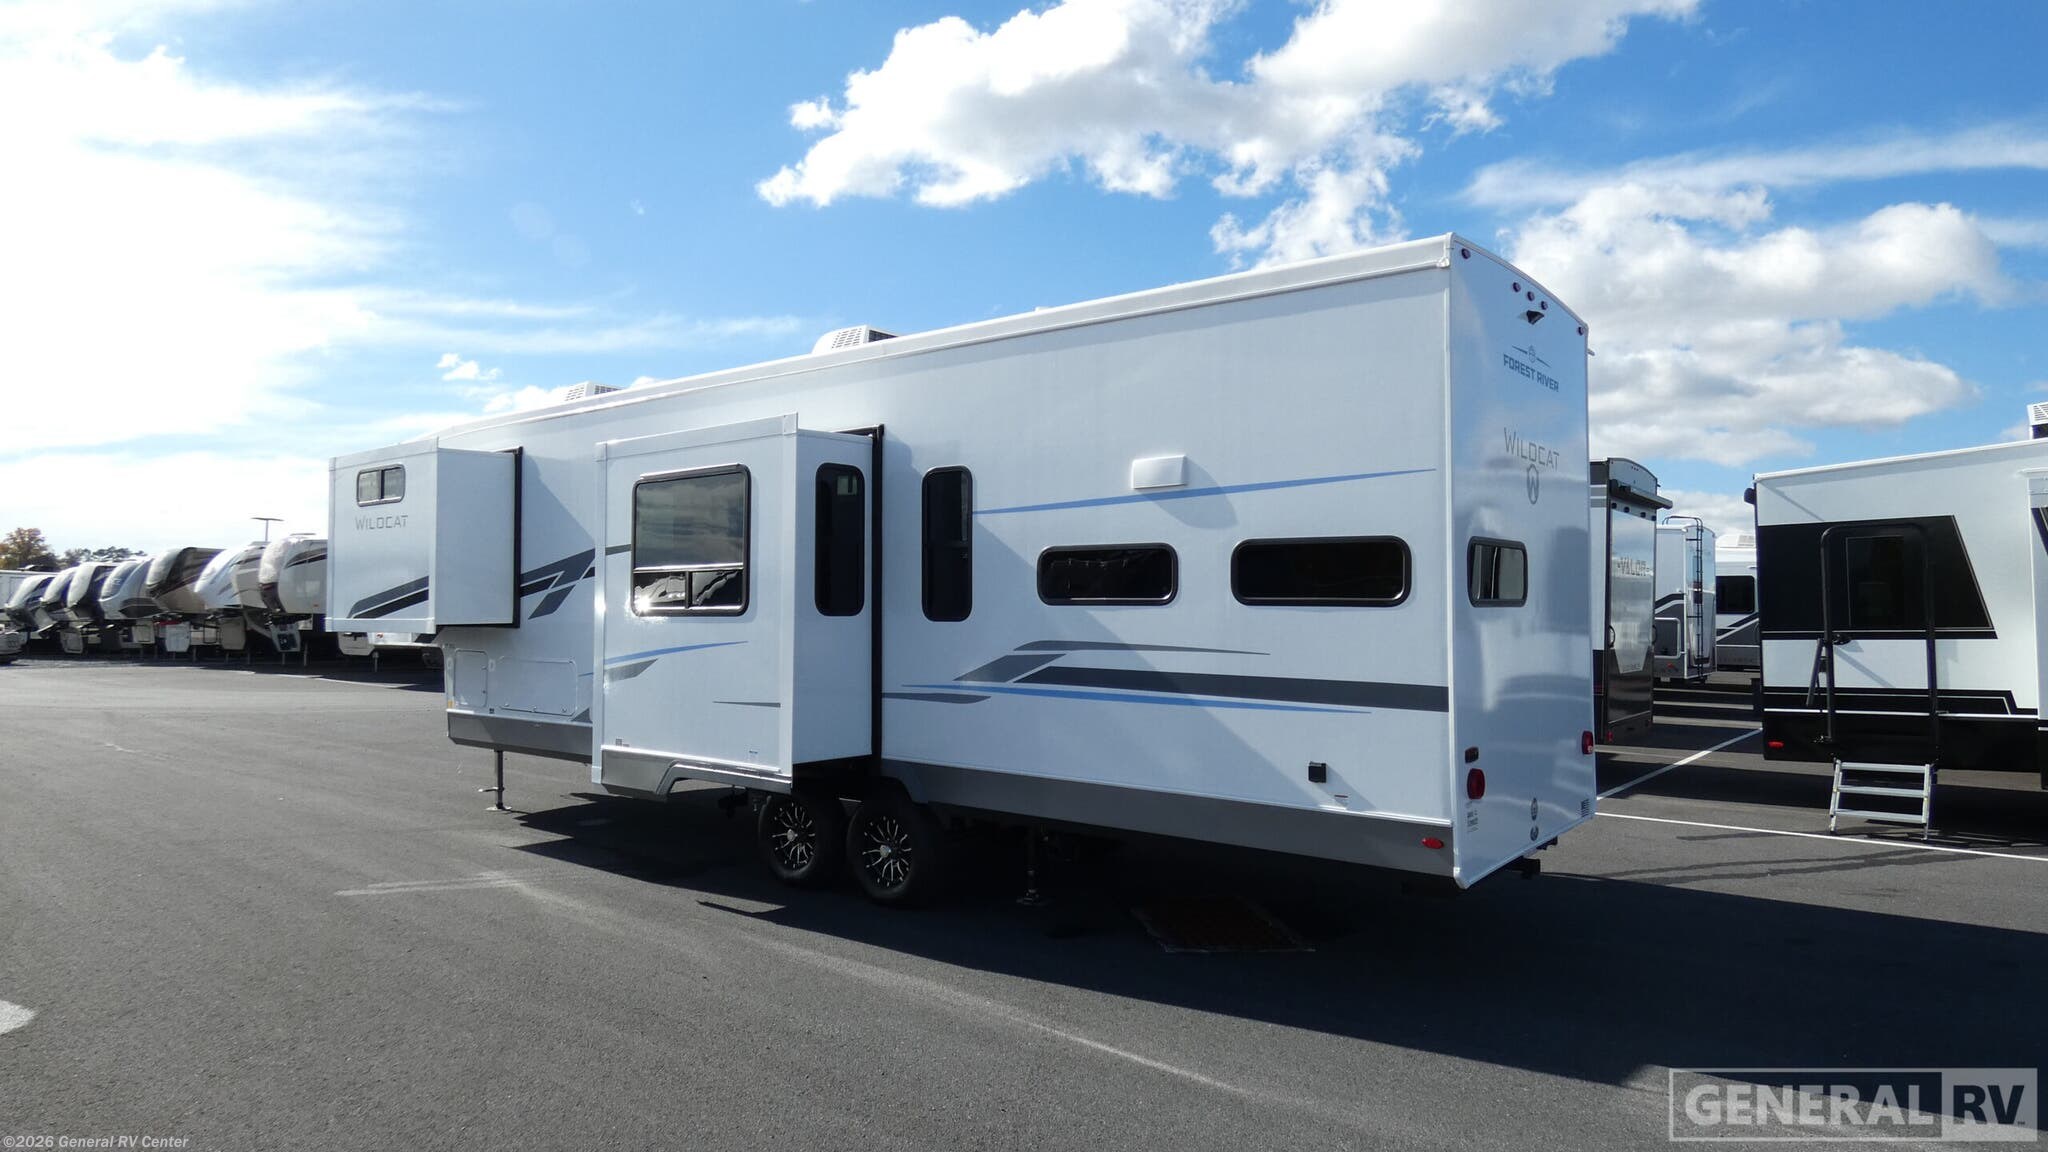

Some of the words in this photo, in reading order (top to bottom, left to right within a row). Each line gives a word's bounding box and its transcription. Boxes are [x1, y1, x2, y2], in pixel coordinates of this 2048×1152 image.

[1503, 354, 1535, 381] FOREST
[1537, 371, 1559, 393] RIVER
[1503, 427, 1560, 472] WILDCAT
[356, 515, 408, 530] WILDCAT
